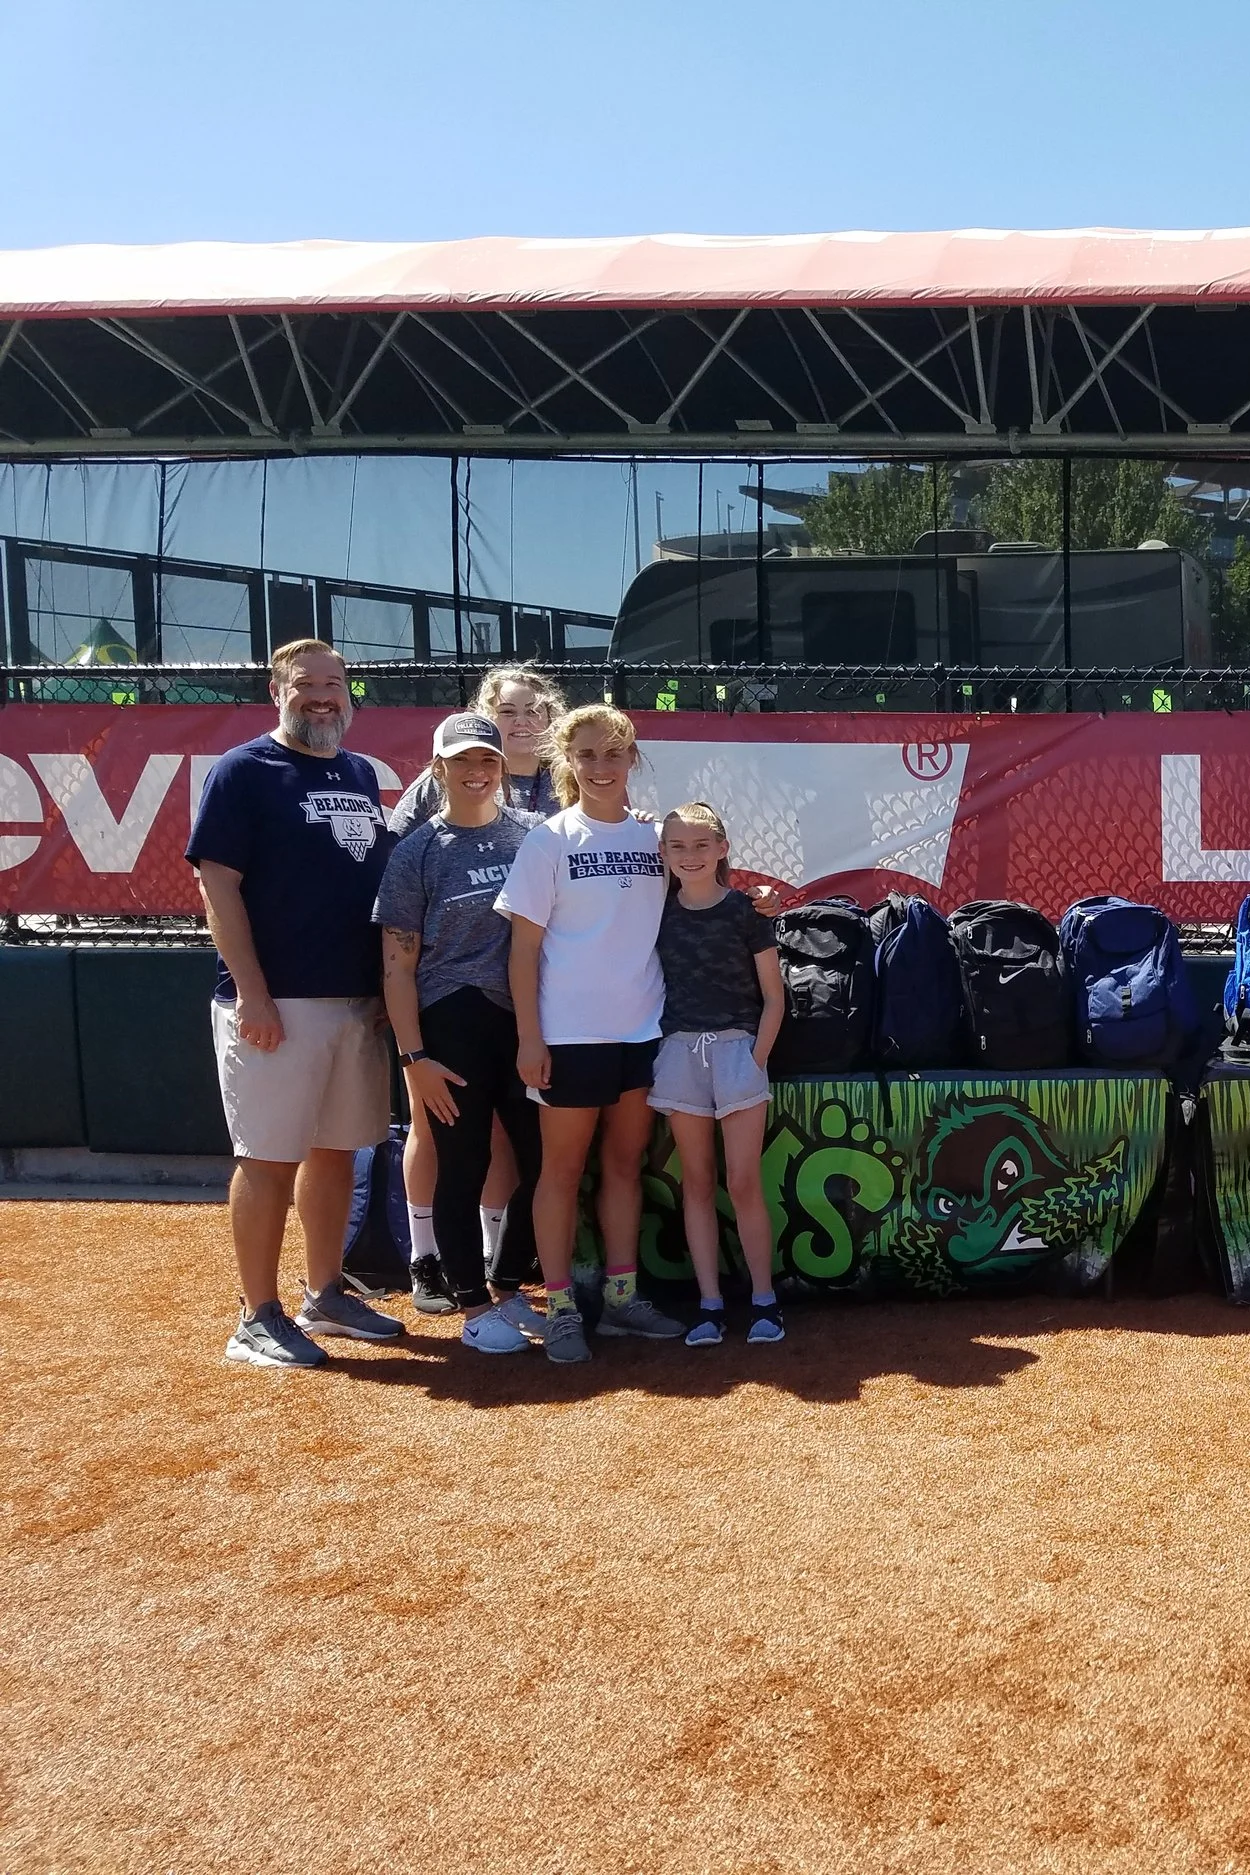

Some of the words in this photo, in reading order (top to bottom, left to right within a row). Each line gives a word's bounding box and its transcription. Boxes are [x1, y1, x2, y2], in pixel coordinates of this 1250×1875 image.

[312, 797, 374, 814] BEACONS
[567, 851, 598, 867] NCU
[577, 864, 664, 878] BASKETBALL
